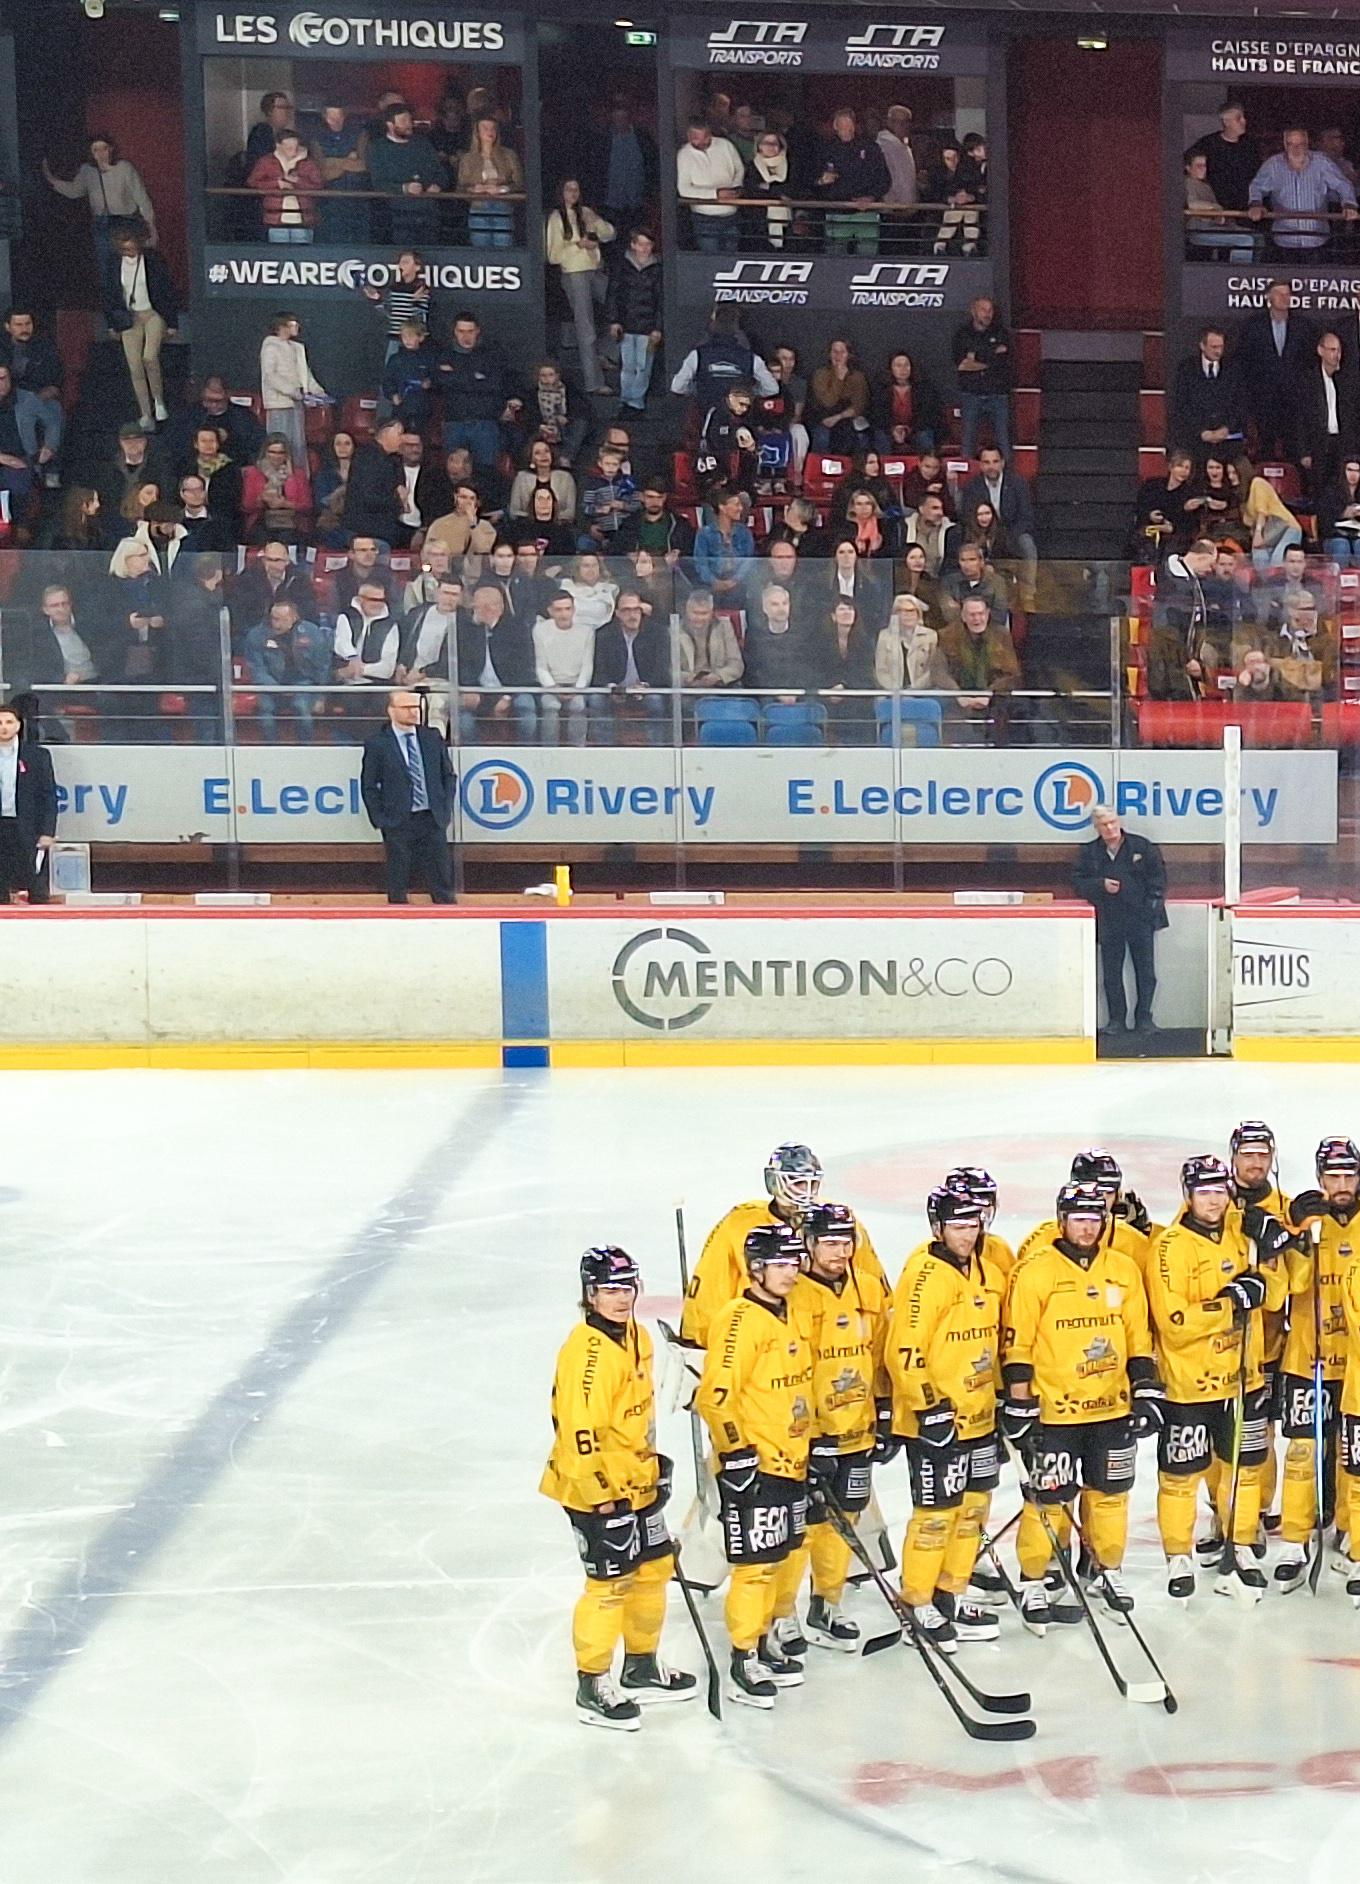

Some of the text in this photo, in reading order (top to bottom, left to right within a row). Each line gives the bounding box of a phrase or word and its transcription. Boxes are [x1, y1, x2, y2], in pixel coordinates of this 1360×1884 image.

[216, 12, 504, 49] LES GOTHIQUES
[1211, 40, 1269, 55] CAISSE
[709, 49, 802, 66] TRANSPORTS
[847, 52, 940, 69] TRANSPORTS
[1211, 58, 1267, 73] HAUTS
[1273, 60, 1295, 74] DE
[715, 288, 808, 305] TRANSPORTS
[851, 291, 944, 308] TRANSPORTS
[1290, 297, 1311, 309] DE
[204, 778, 360, 814] E.Lecl
[546, 779, 715, 826] Rivery
[788, 780, 1024, 815] E.Leclerc
[1117, 781, 1278, 827] Rivey
[643, 957, 1013, 997] MENTION&CO
[1170, 1424, 1207, 1446] ECO
